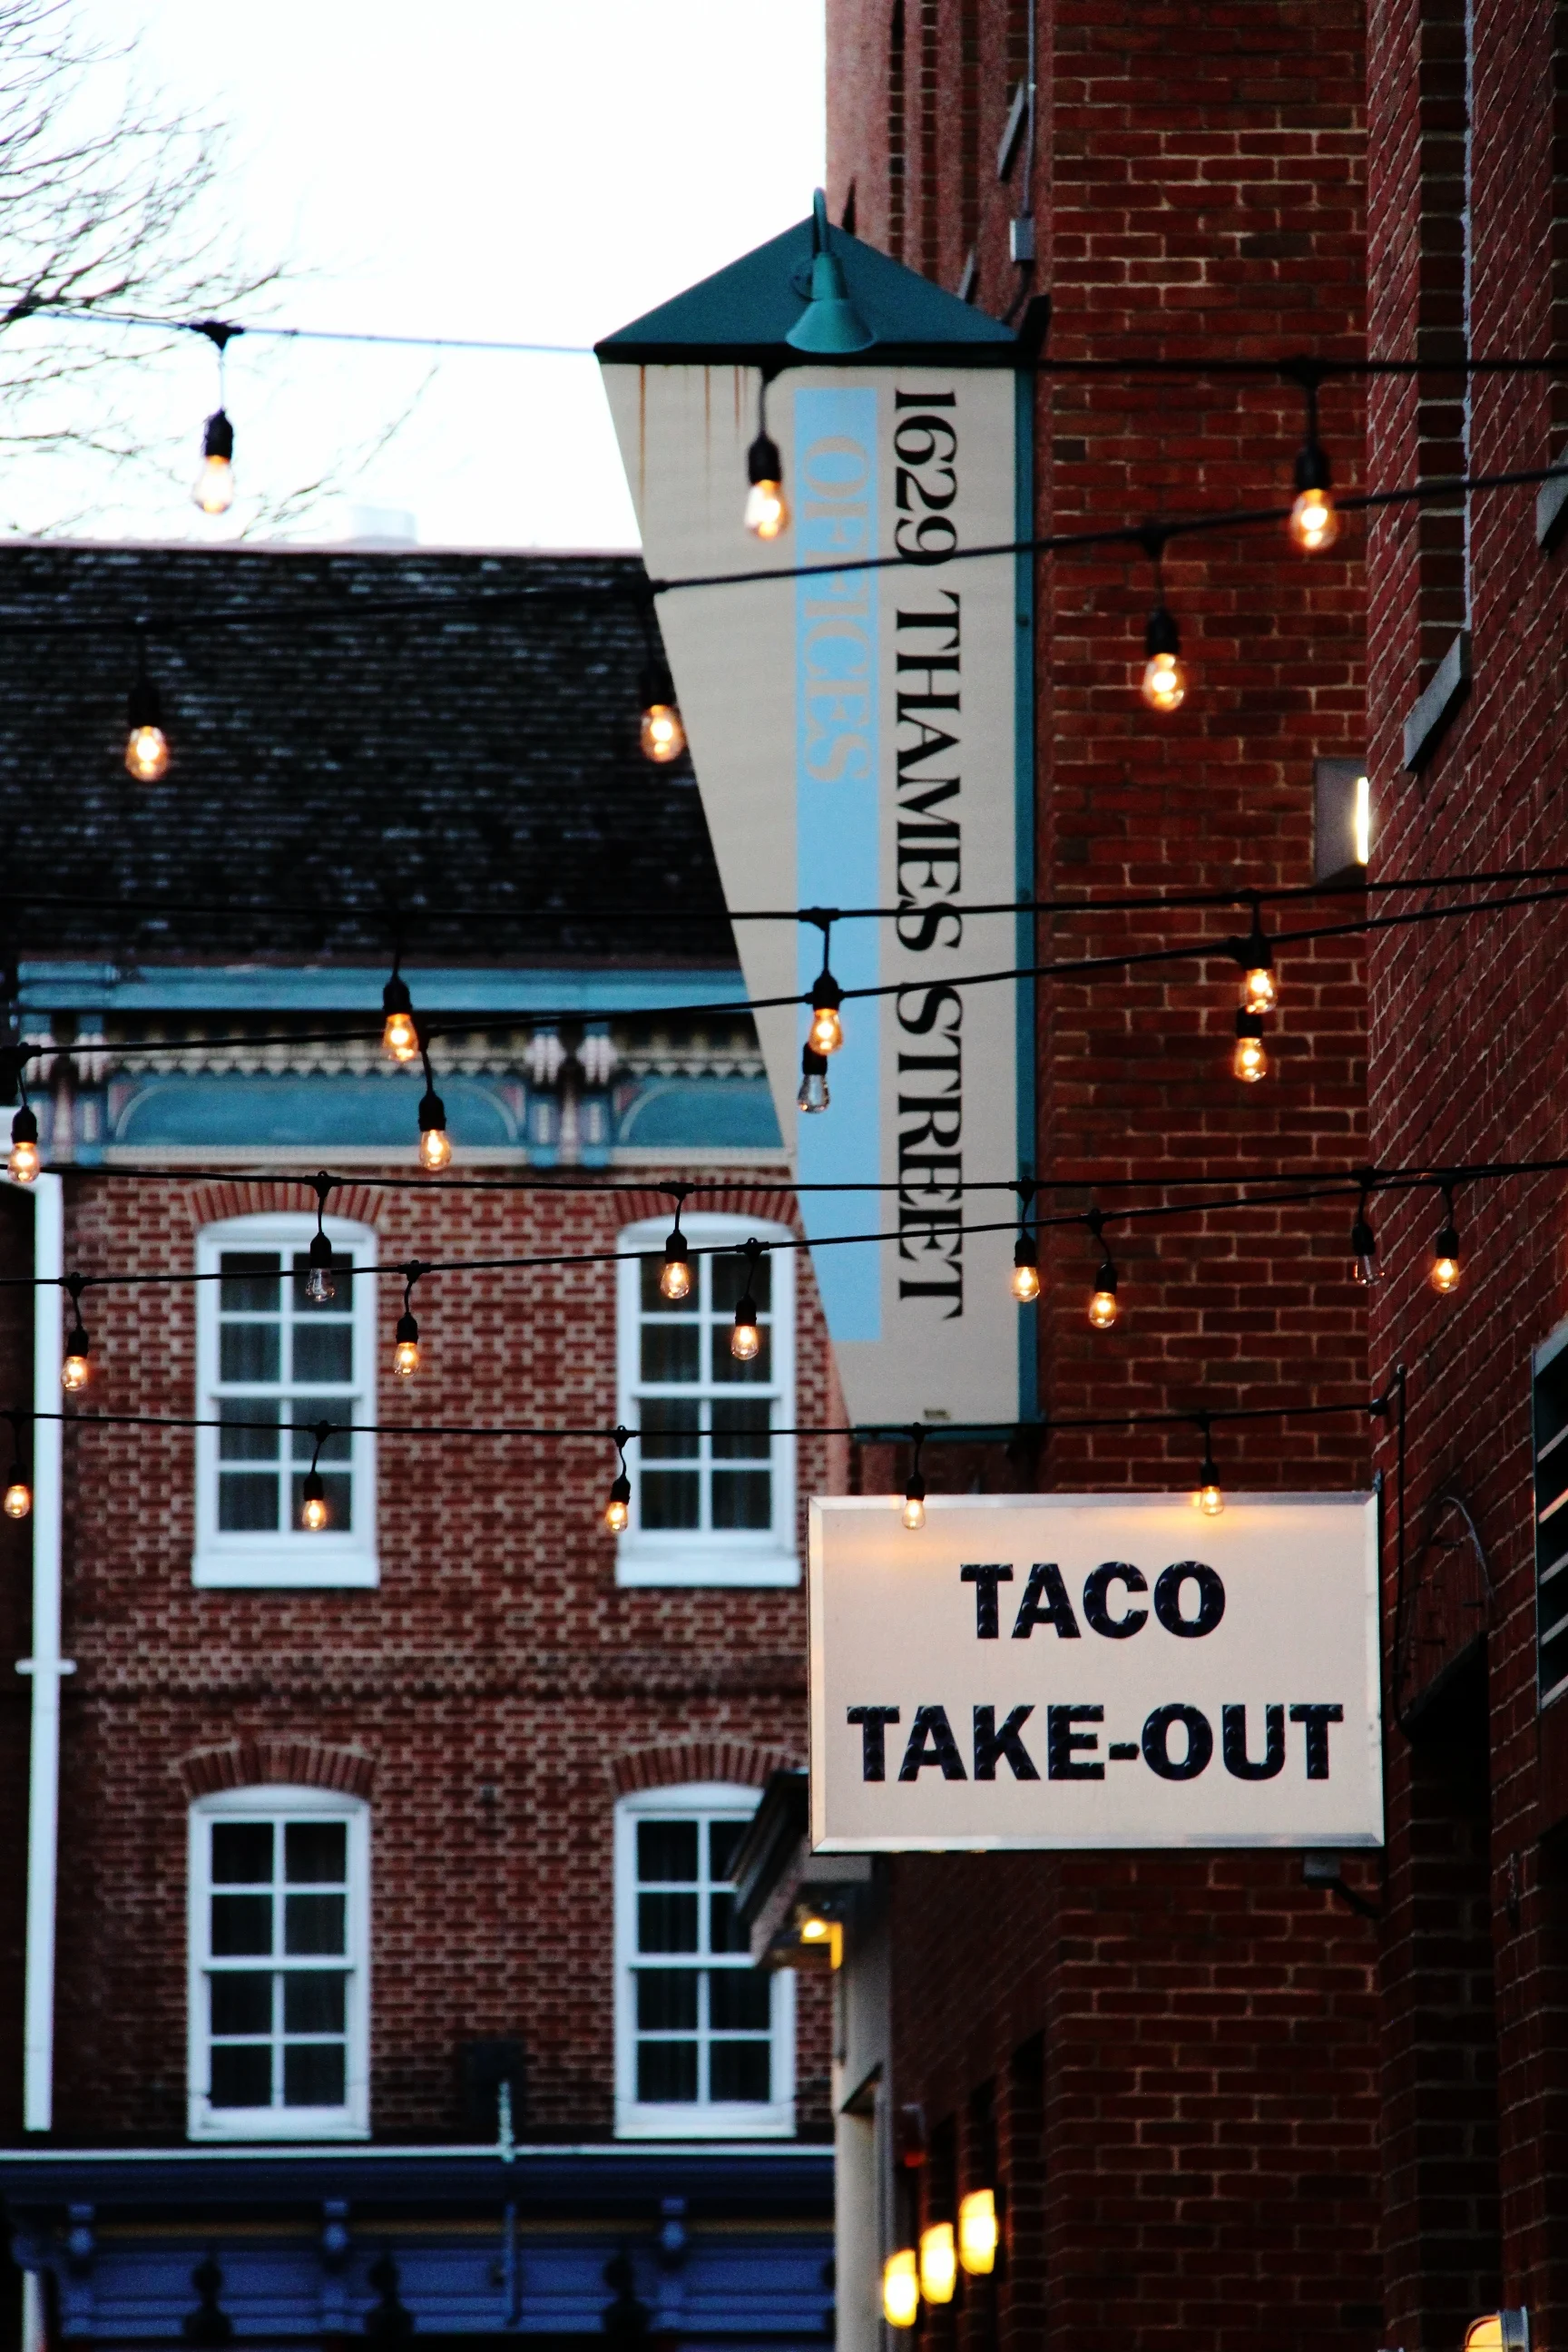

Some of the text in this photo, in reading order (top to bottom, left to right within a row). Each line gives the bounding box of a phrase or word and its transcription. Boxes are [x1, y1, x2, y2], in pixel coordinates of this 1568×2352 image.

[804, 436, 871, 782] OFFICES
[894, 388, 964, 1319] 1629 THAMES STREET
[960, 1561, 1226, 1640] TACO
[847, 1702, 1344, 1781] TAKE-OUT
